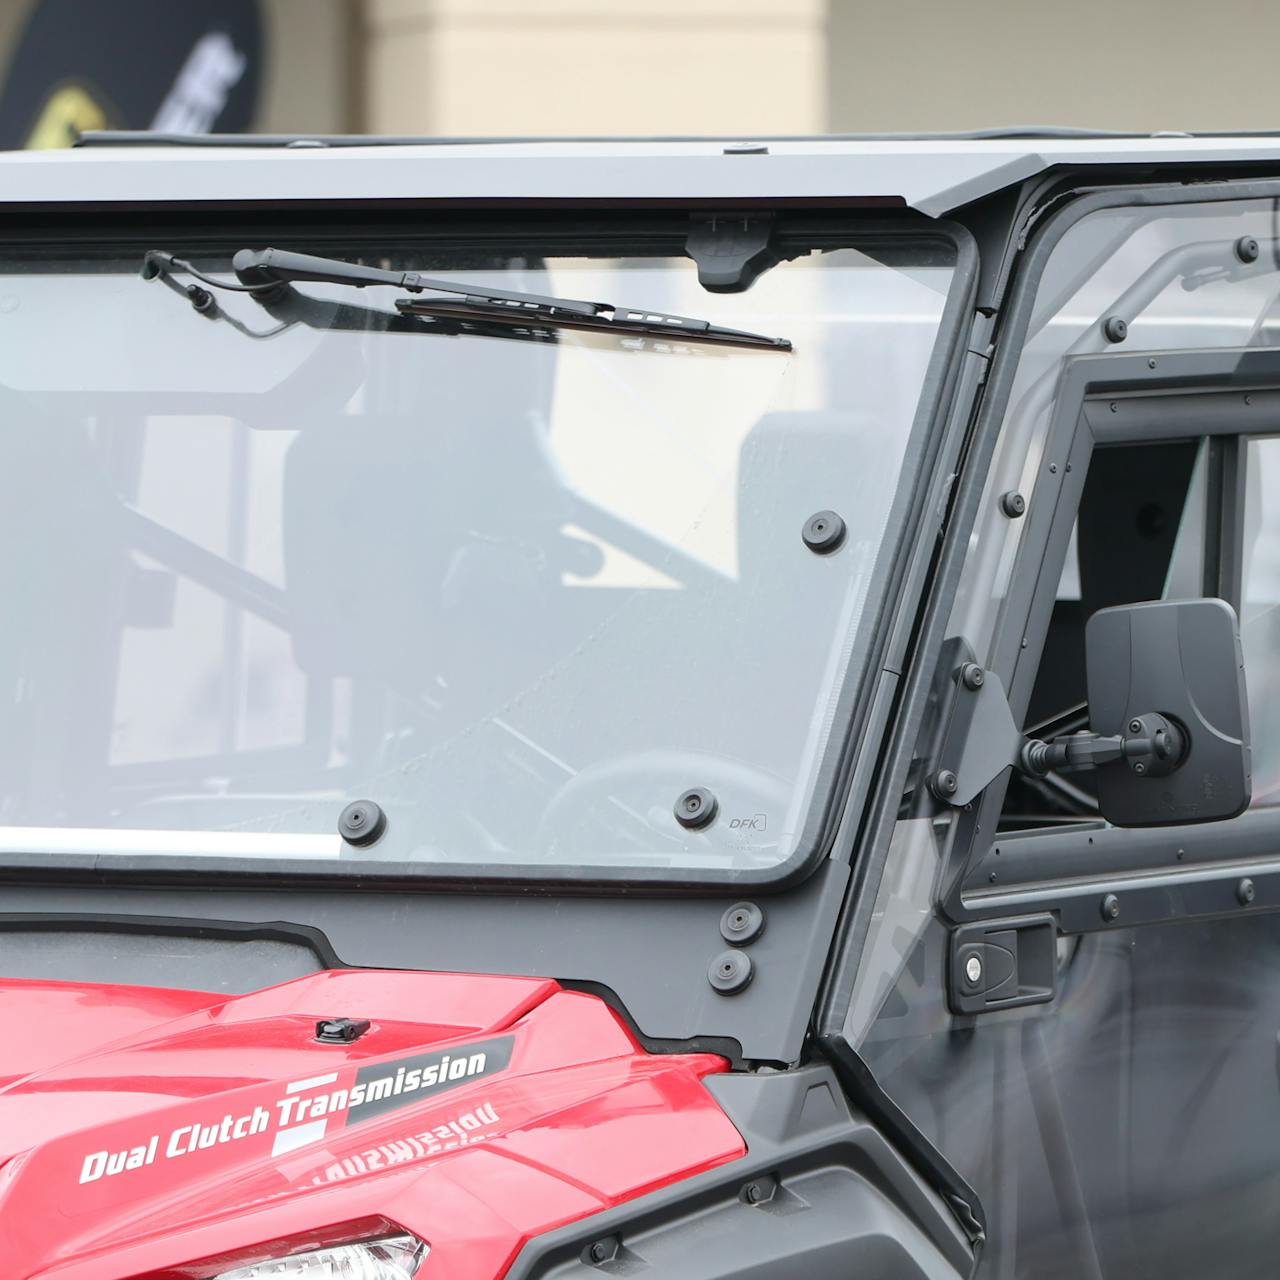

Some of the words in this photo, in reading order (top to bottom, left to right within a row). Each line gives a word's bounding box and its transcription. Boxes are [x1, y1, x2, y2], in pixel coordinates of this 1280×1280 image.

[728, 818, 759, 830] DFK
[78, 1135, 160, 1185] Dual
[165, 1105, 271, 1159] Clutch
[275, 1052, 487, 1127] Transmission
